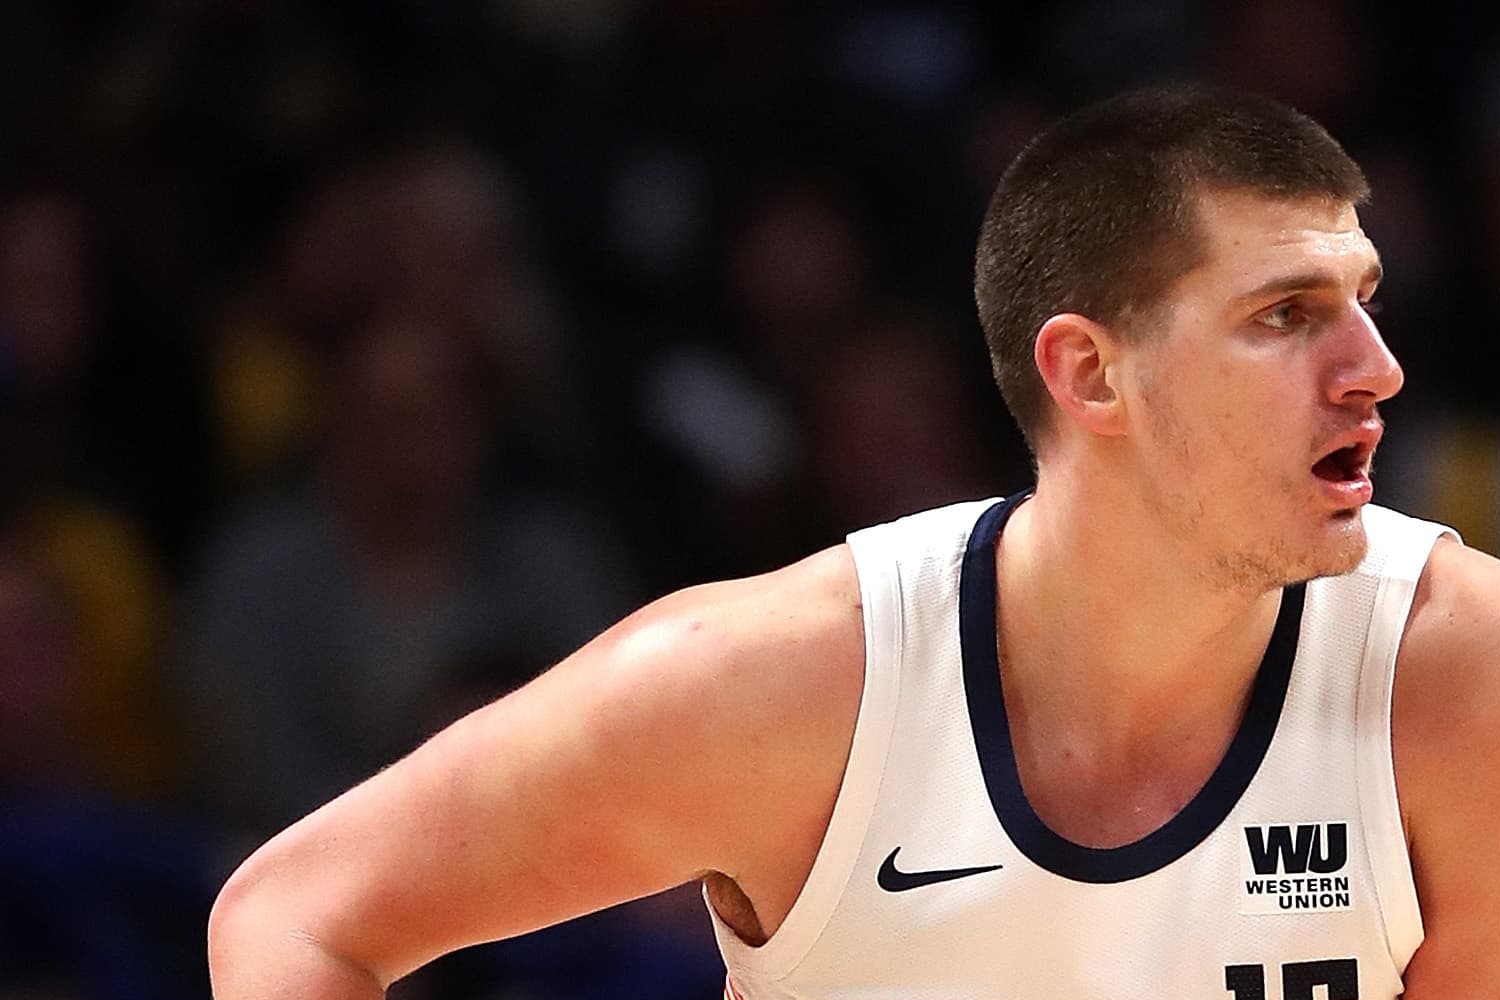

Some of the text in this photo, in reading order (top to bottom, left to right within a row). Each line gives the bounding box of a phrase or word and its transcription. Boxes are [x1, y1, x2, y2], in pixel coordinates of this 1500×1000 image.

[1244, 823, 1348, 875] WU
[1245, 877, 1350, 895] WESTERN
[1278, 892, 1350, 910] UNION
